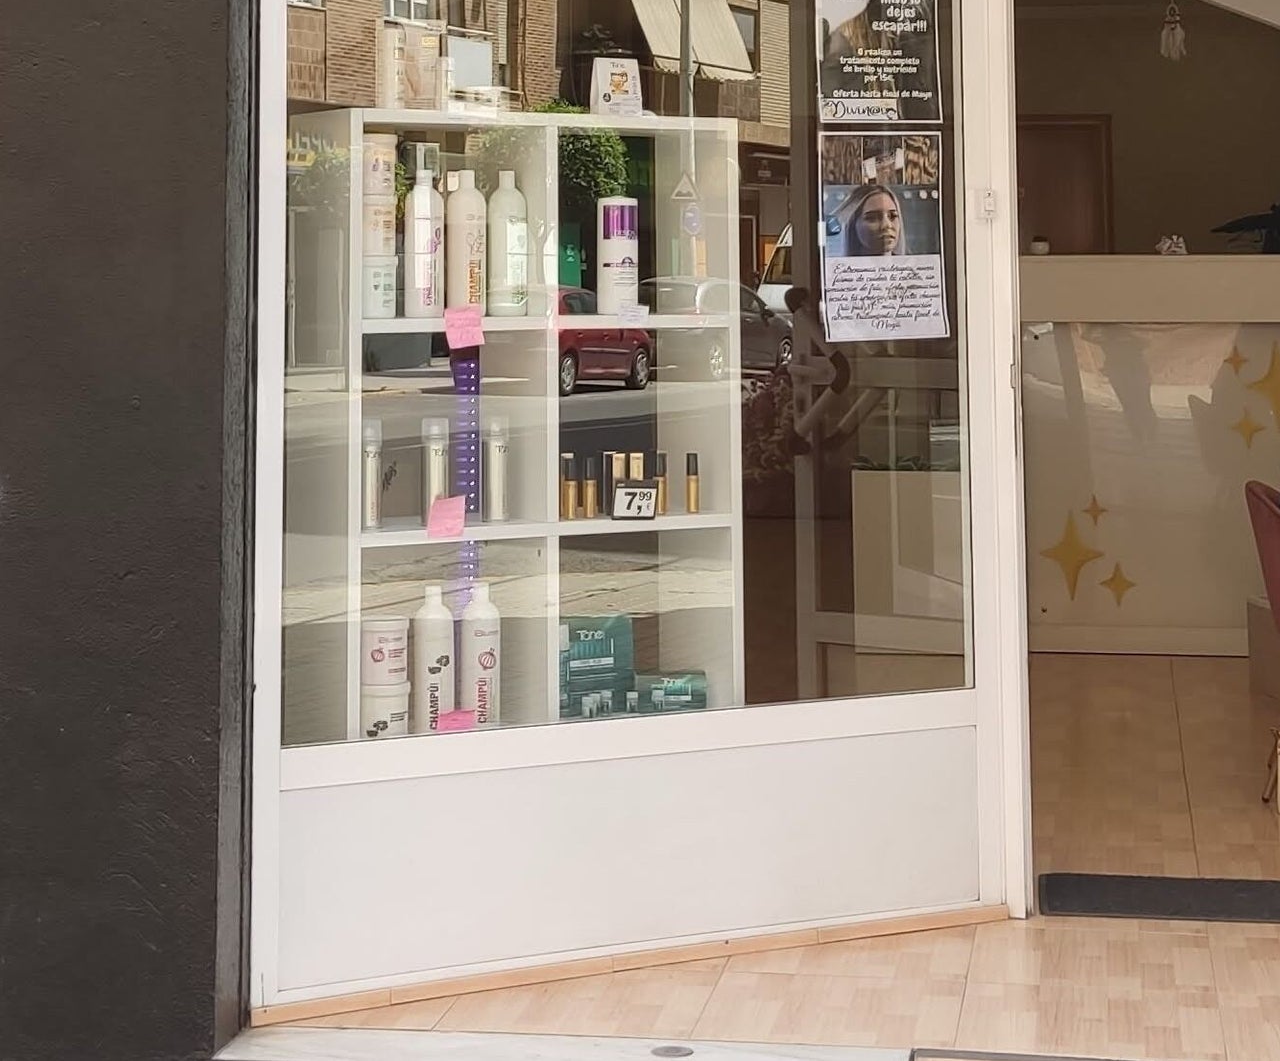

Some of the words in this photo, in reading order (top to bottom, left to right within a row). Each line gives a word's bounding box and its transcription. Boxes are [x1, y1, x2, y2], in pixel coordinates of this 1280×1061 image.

[840, 56, 885, 65] tratamiento
[887, 57, 919, 67] completo
[864, 74, 877, 83] por
[833, 89, 859, 98] Oferta
[860, 89, 881, 98] hasta
[901, 90, 911, 98] de
[911, 91, 933, 101] Mayo
